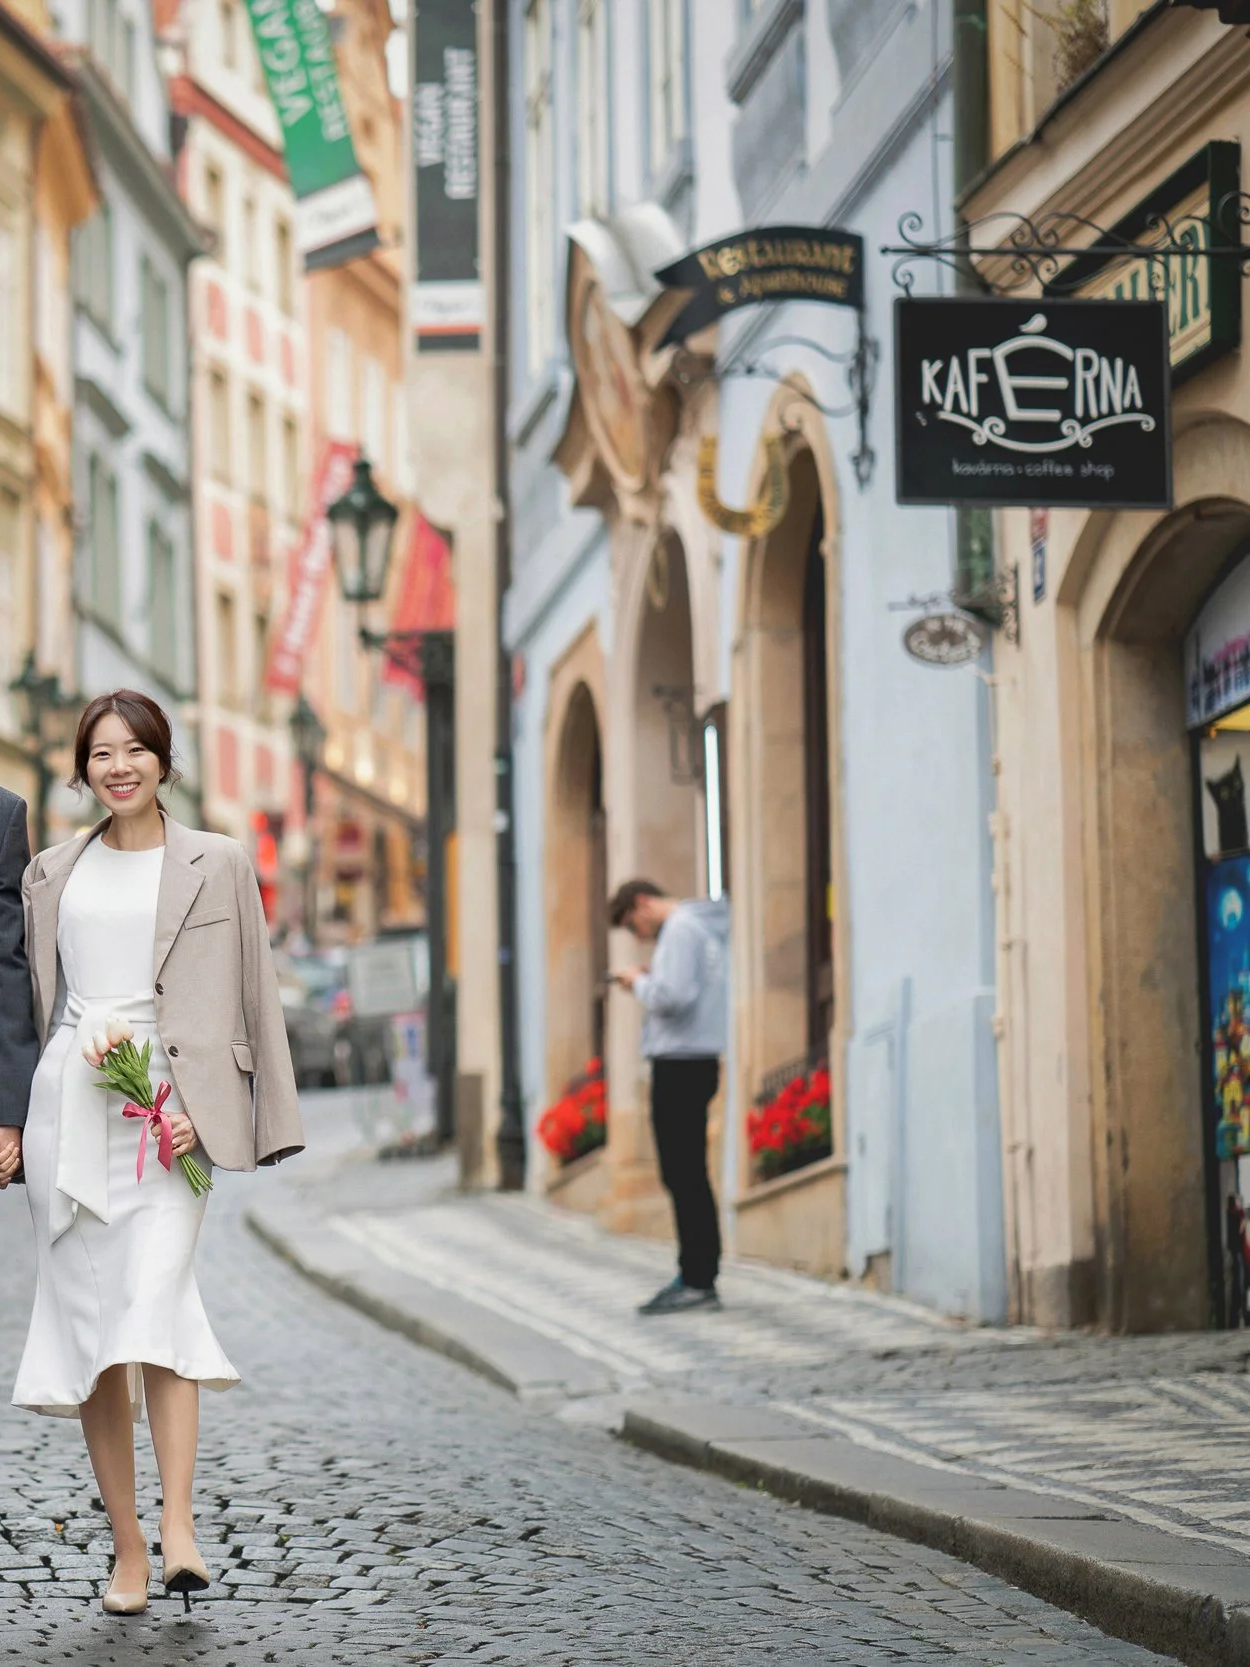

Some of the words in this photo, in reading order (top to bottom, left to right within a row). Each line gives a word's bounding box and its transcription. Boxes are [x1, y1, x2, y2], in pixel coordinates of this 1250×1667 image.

[921, 335, 1143, 422] KAFERNA
[1025, 459, 1073, 477] coffee
[1080, 460, 1114, 480] shop
